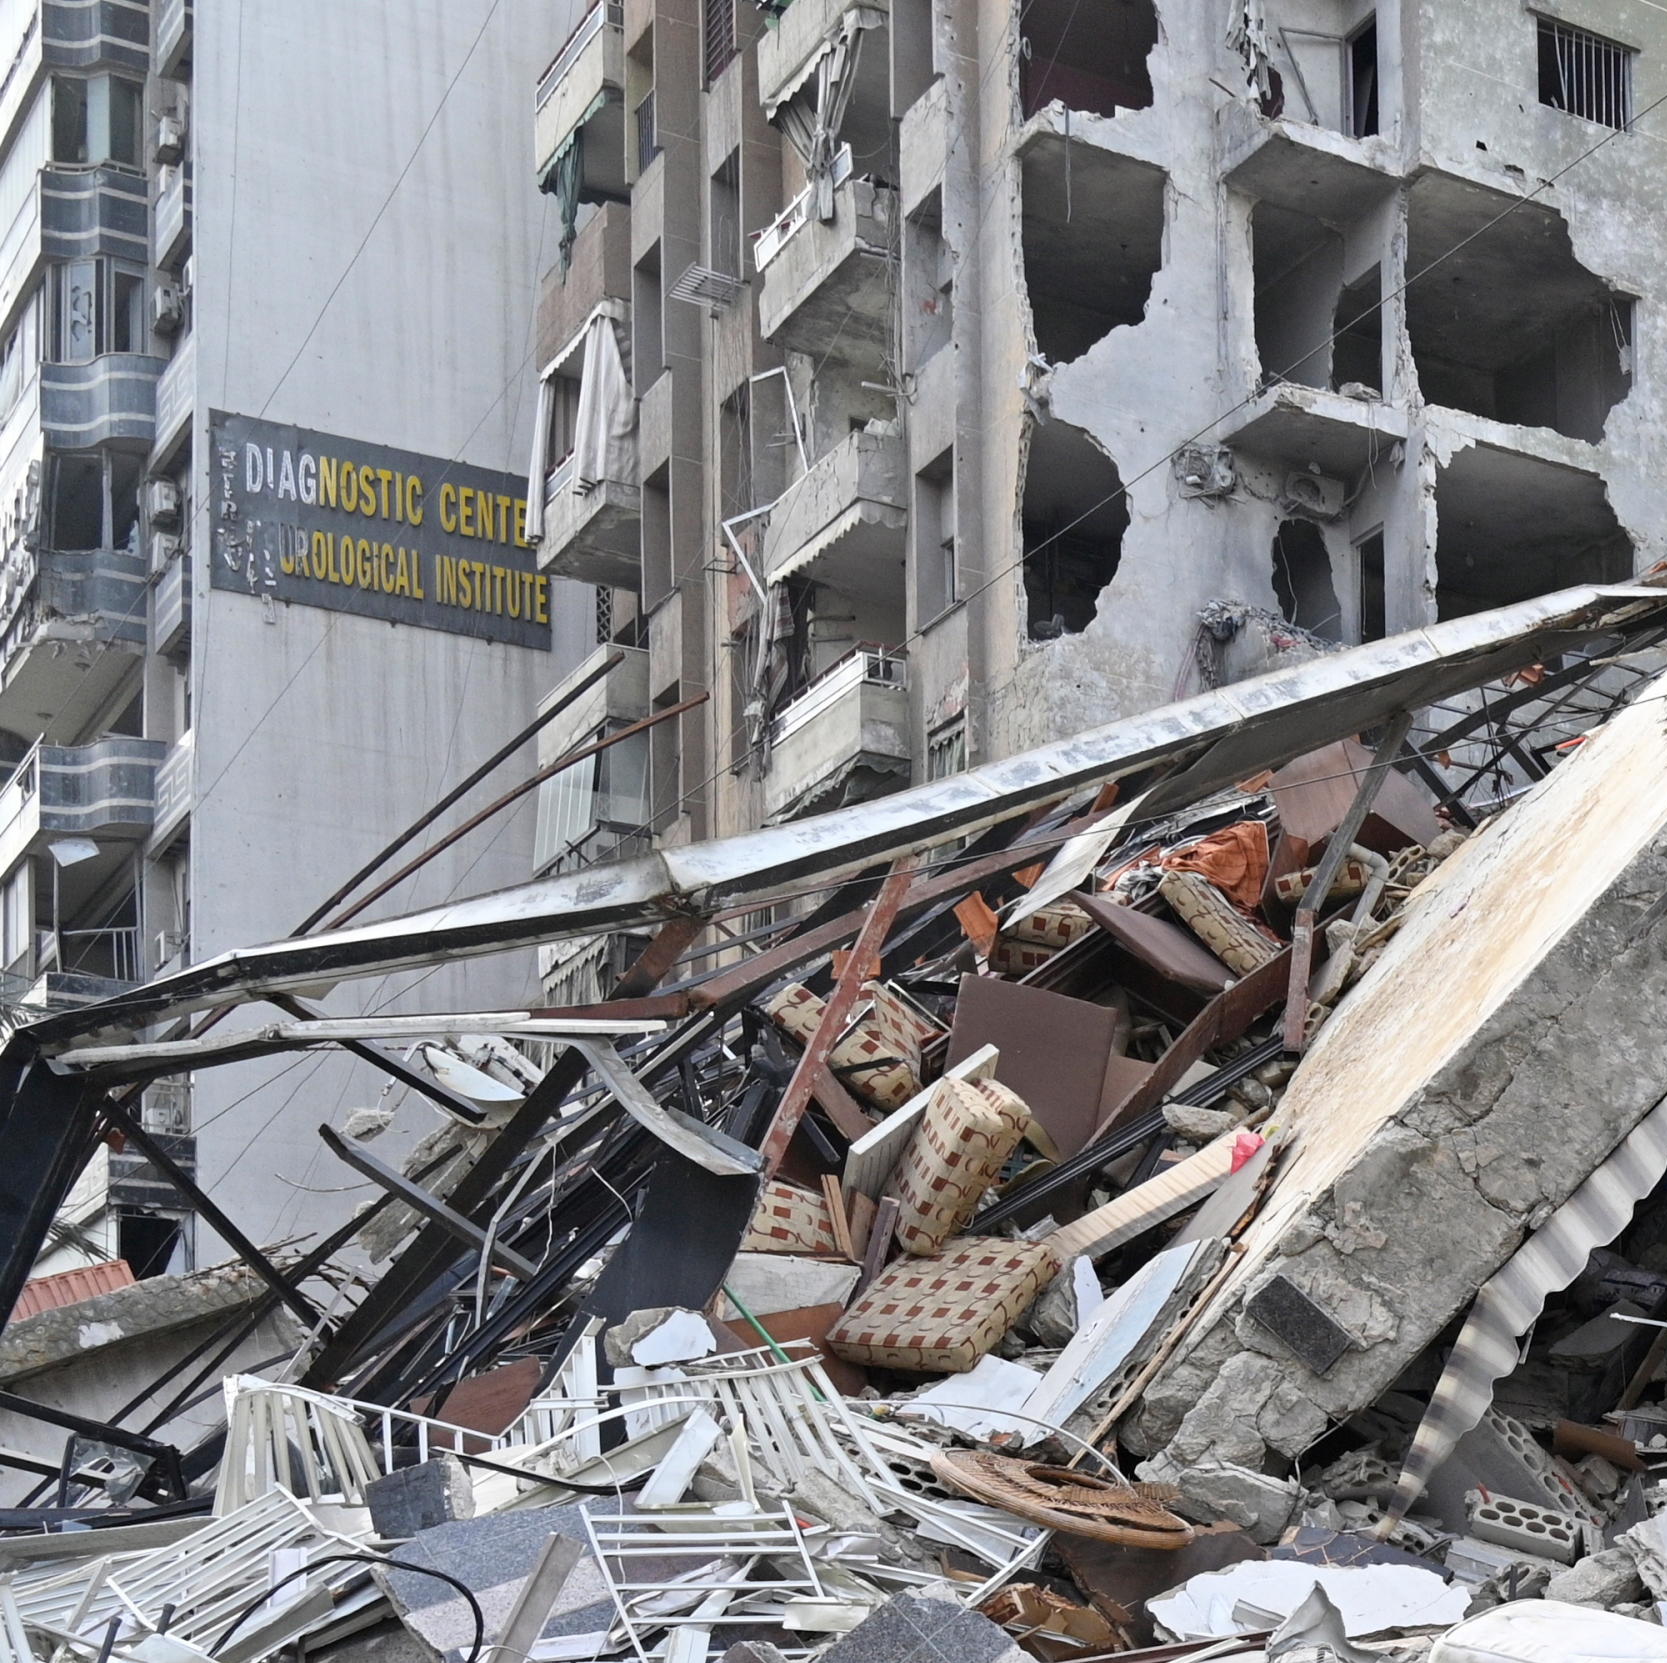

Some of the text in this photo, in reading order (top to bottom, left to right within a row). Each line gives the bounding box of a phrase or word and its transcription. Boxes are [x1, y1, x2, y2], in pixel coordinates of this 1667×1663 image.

[246, 442, 537, 550] DIAGNOSTIC CENTE
[278, 521, 425, 601] UROLOGICAL
[435, 554, 549, 625] INSTITUTE
